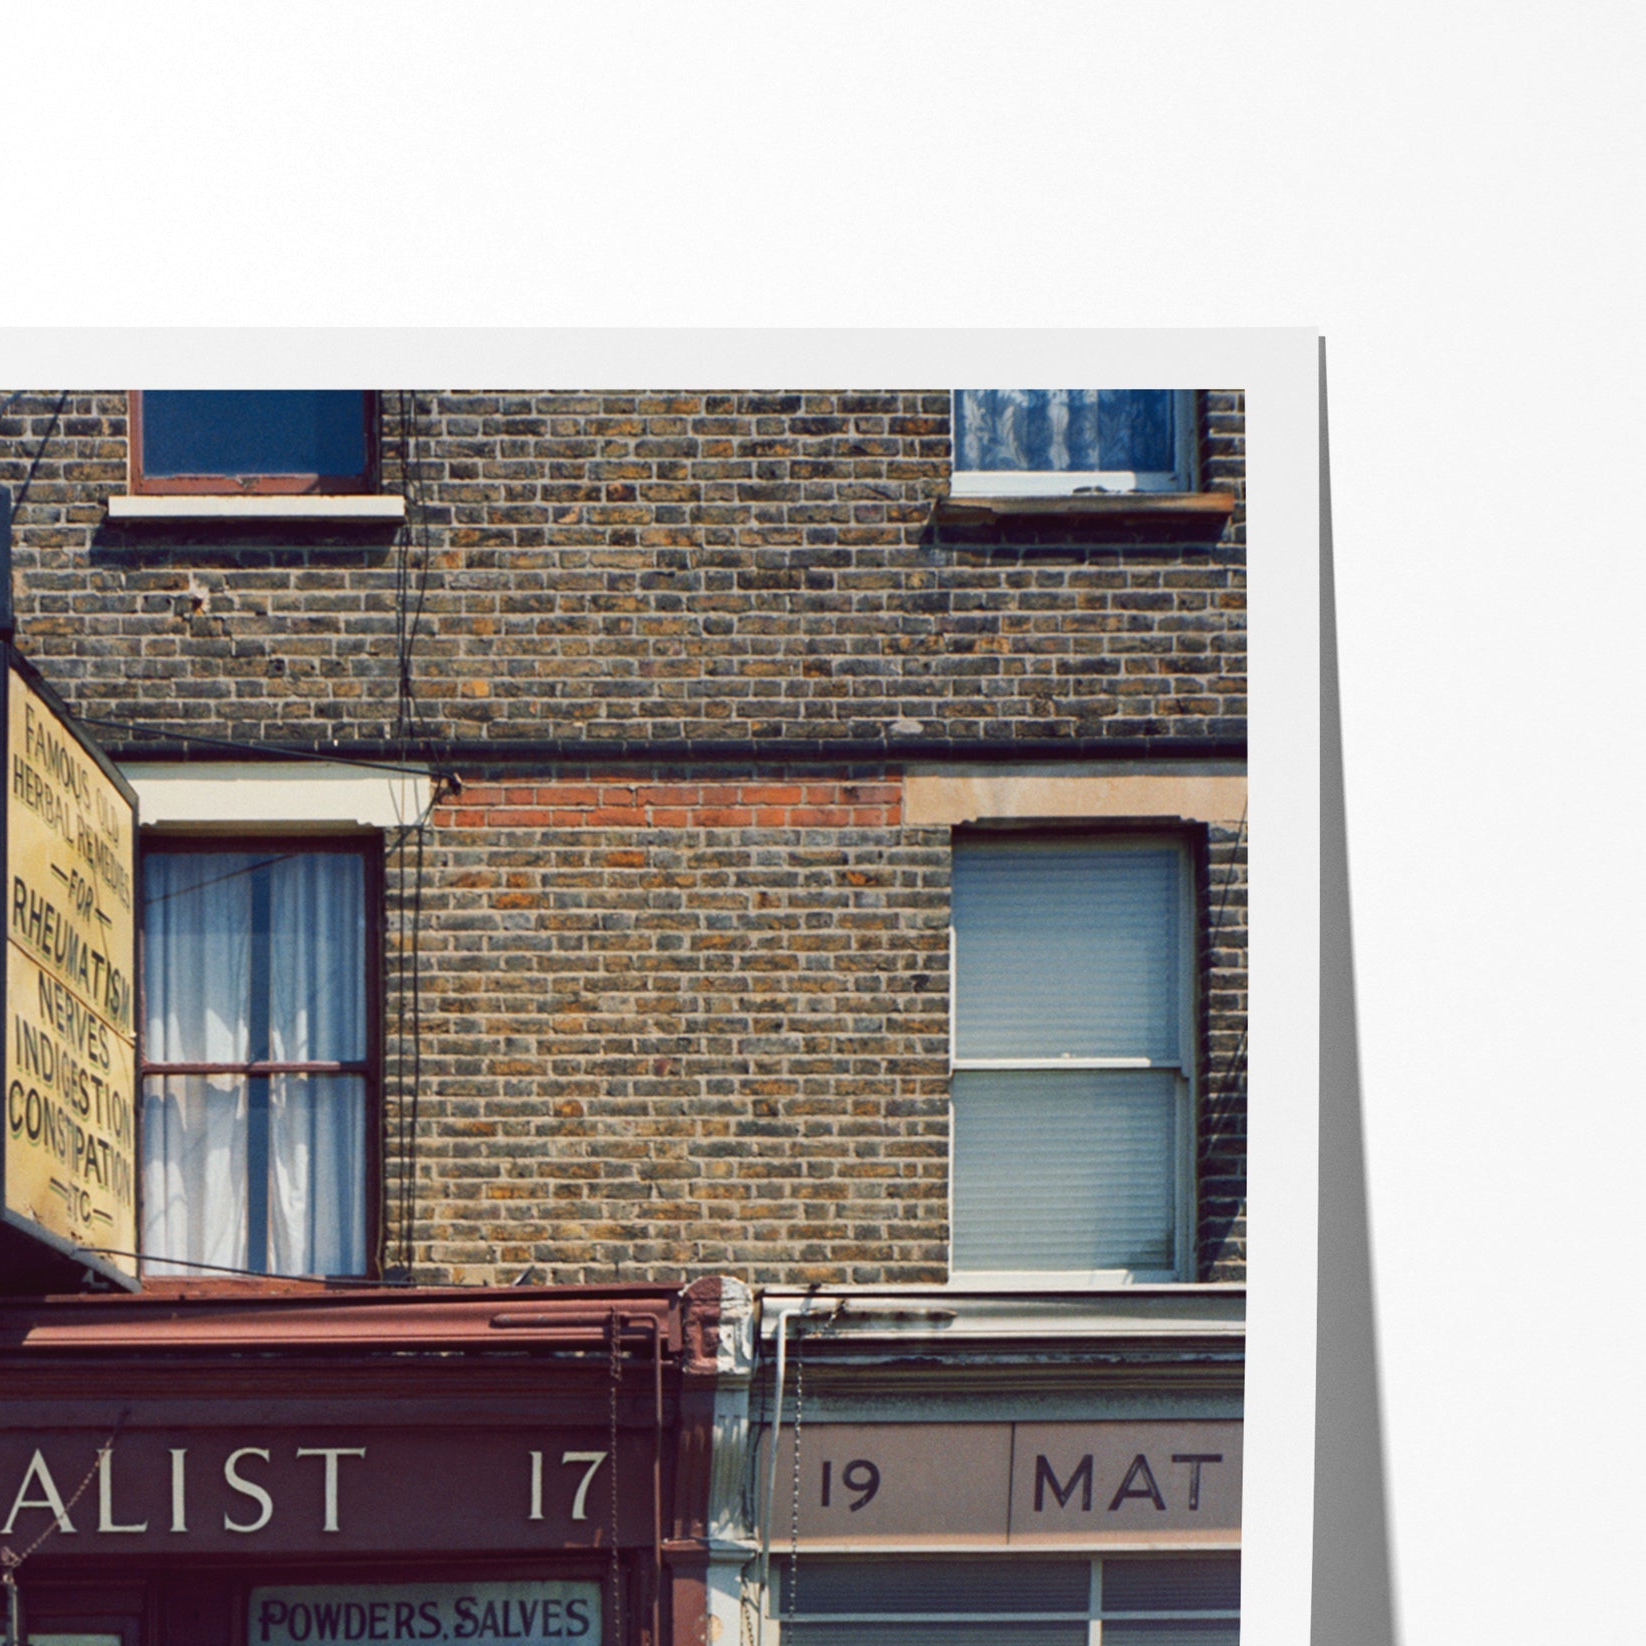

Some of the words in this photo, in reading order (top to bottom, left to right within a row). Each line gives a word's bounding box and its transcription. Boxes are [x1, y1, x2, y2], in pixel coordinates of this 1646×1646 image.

[24, 702, 92, 812] FAMOUS
[95, 786, 120, 845] OLD
[13, 753, 74, 845] HERBAL
[76, 813, 130, 911] REMEDIES
[67, 867, 95, 923] FOR
[12, 875, 132, 1030] RHEUMATISM
[38, 969, 111, 1069] NERVES
[15, 1013, 131, 1151] INDIGESTION
[8, 1079, 132, 1206] CONSTIPATION
[66, 1181, 92, 1224] ETC
[527, 1449, 609, 1521] 17
[819, 1459, 881, 1512] 19
[1032, 1453, 1224, 1512] MAT
[453, 1596, 591, 1639] SALVES
